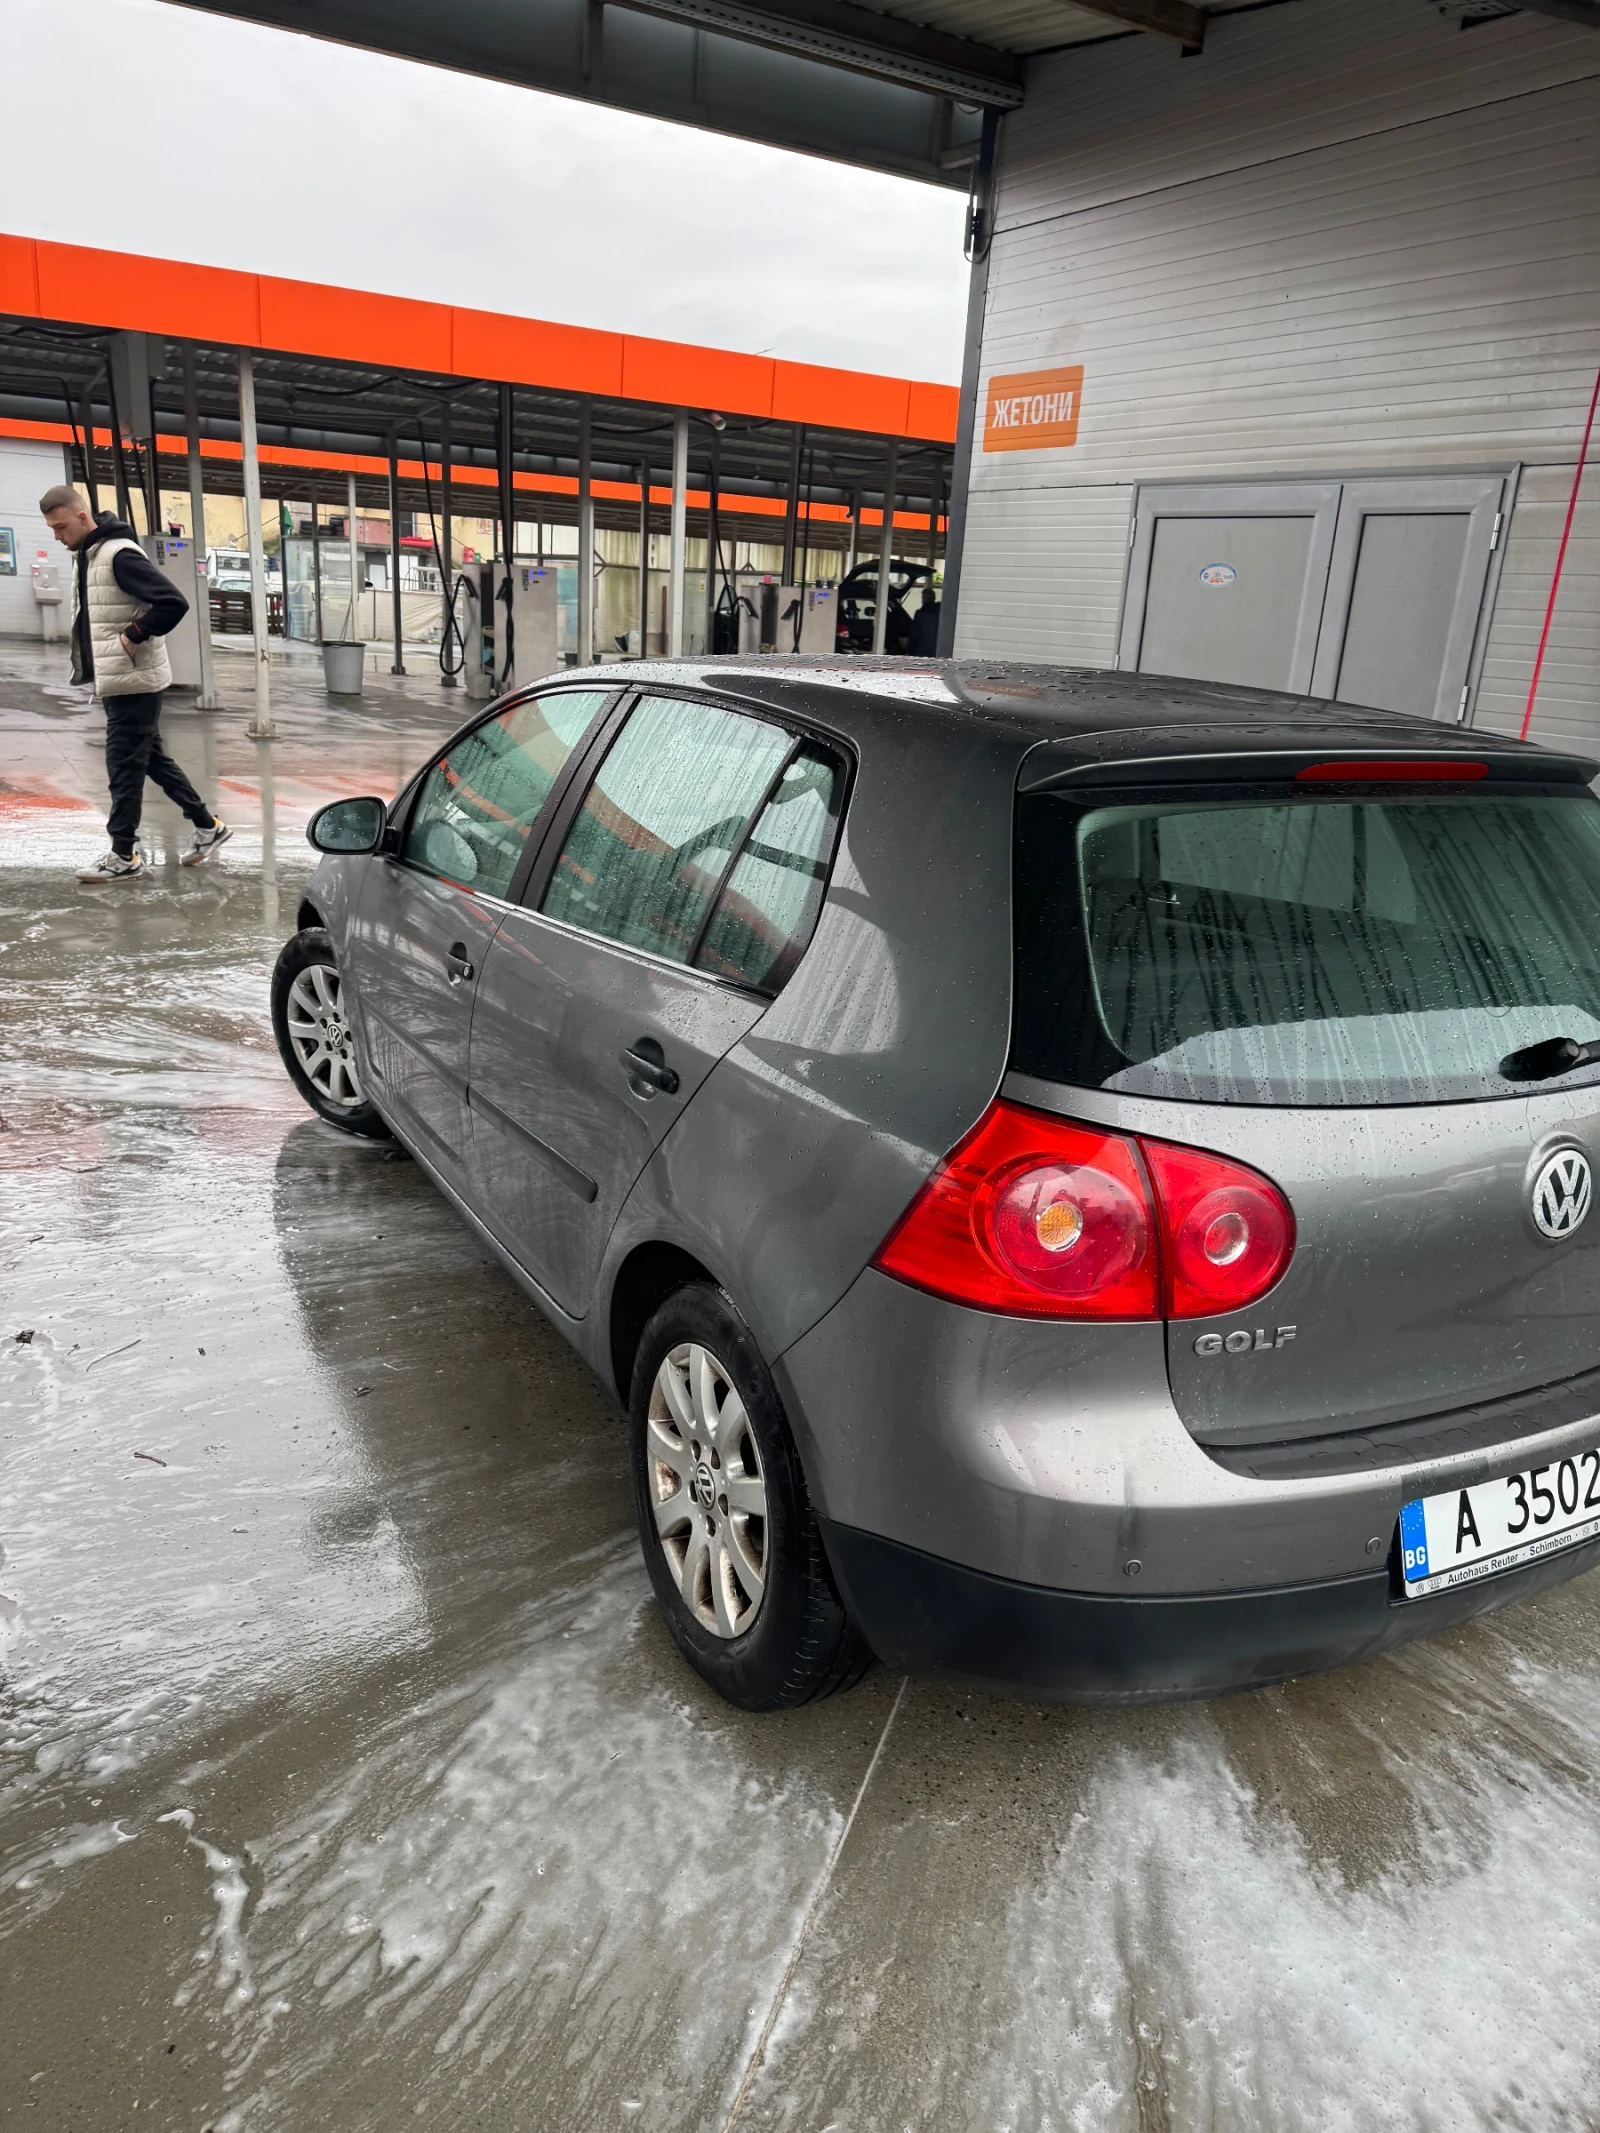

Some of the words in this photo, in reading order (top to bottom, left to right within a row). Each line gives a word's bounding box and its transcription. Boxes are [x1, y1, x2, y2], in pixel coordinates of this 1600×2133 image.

[991, 391, 1074, 428] ЖЕТОНИ
[1193, 1325, 1297, 1356] GOLF
[1455, 1489, 1481, 1554] A
[1507, 1449, 1600, 1534] 3502
[1405, 1546, 1426, 1569] BG
[1447, 1564, 1489, 1585] Autohaus
[1491, 1553, 1519, 1570] Reuter
[1529, 1534, 1572, 1556] Schimborn
